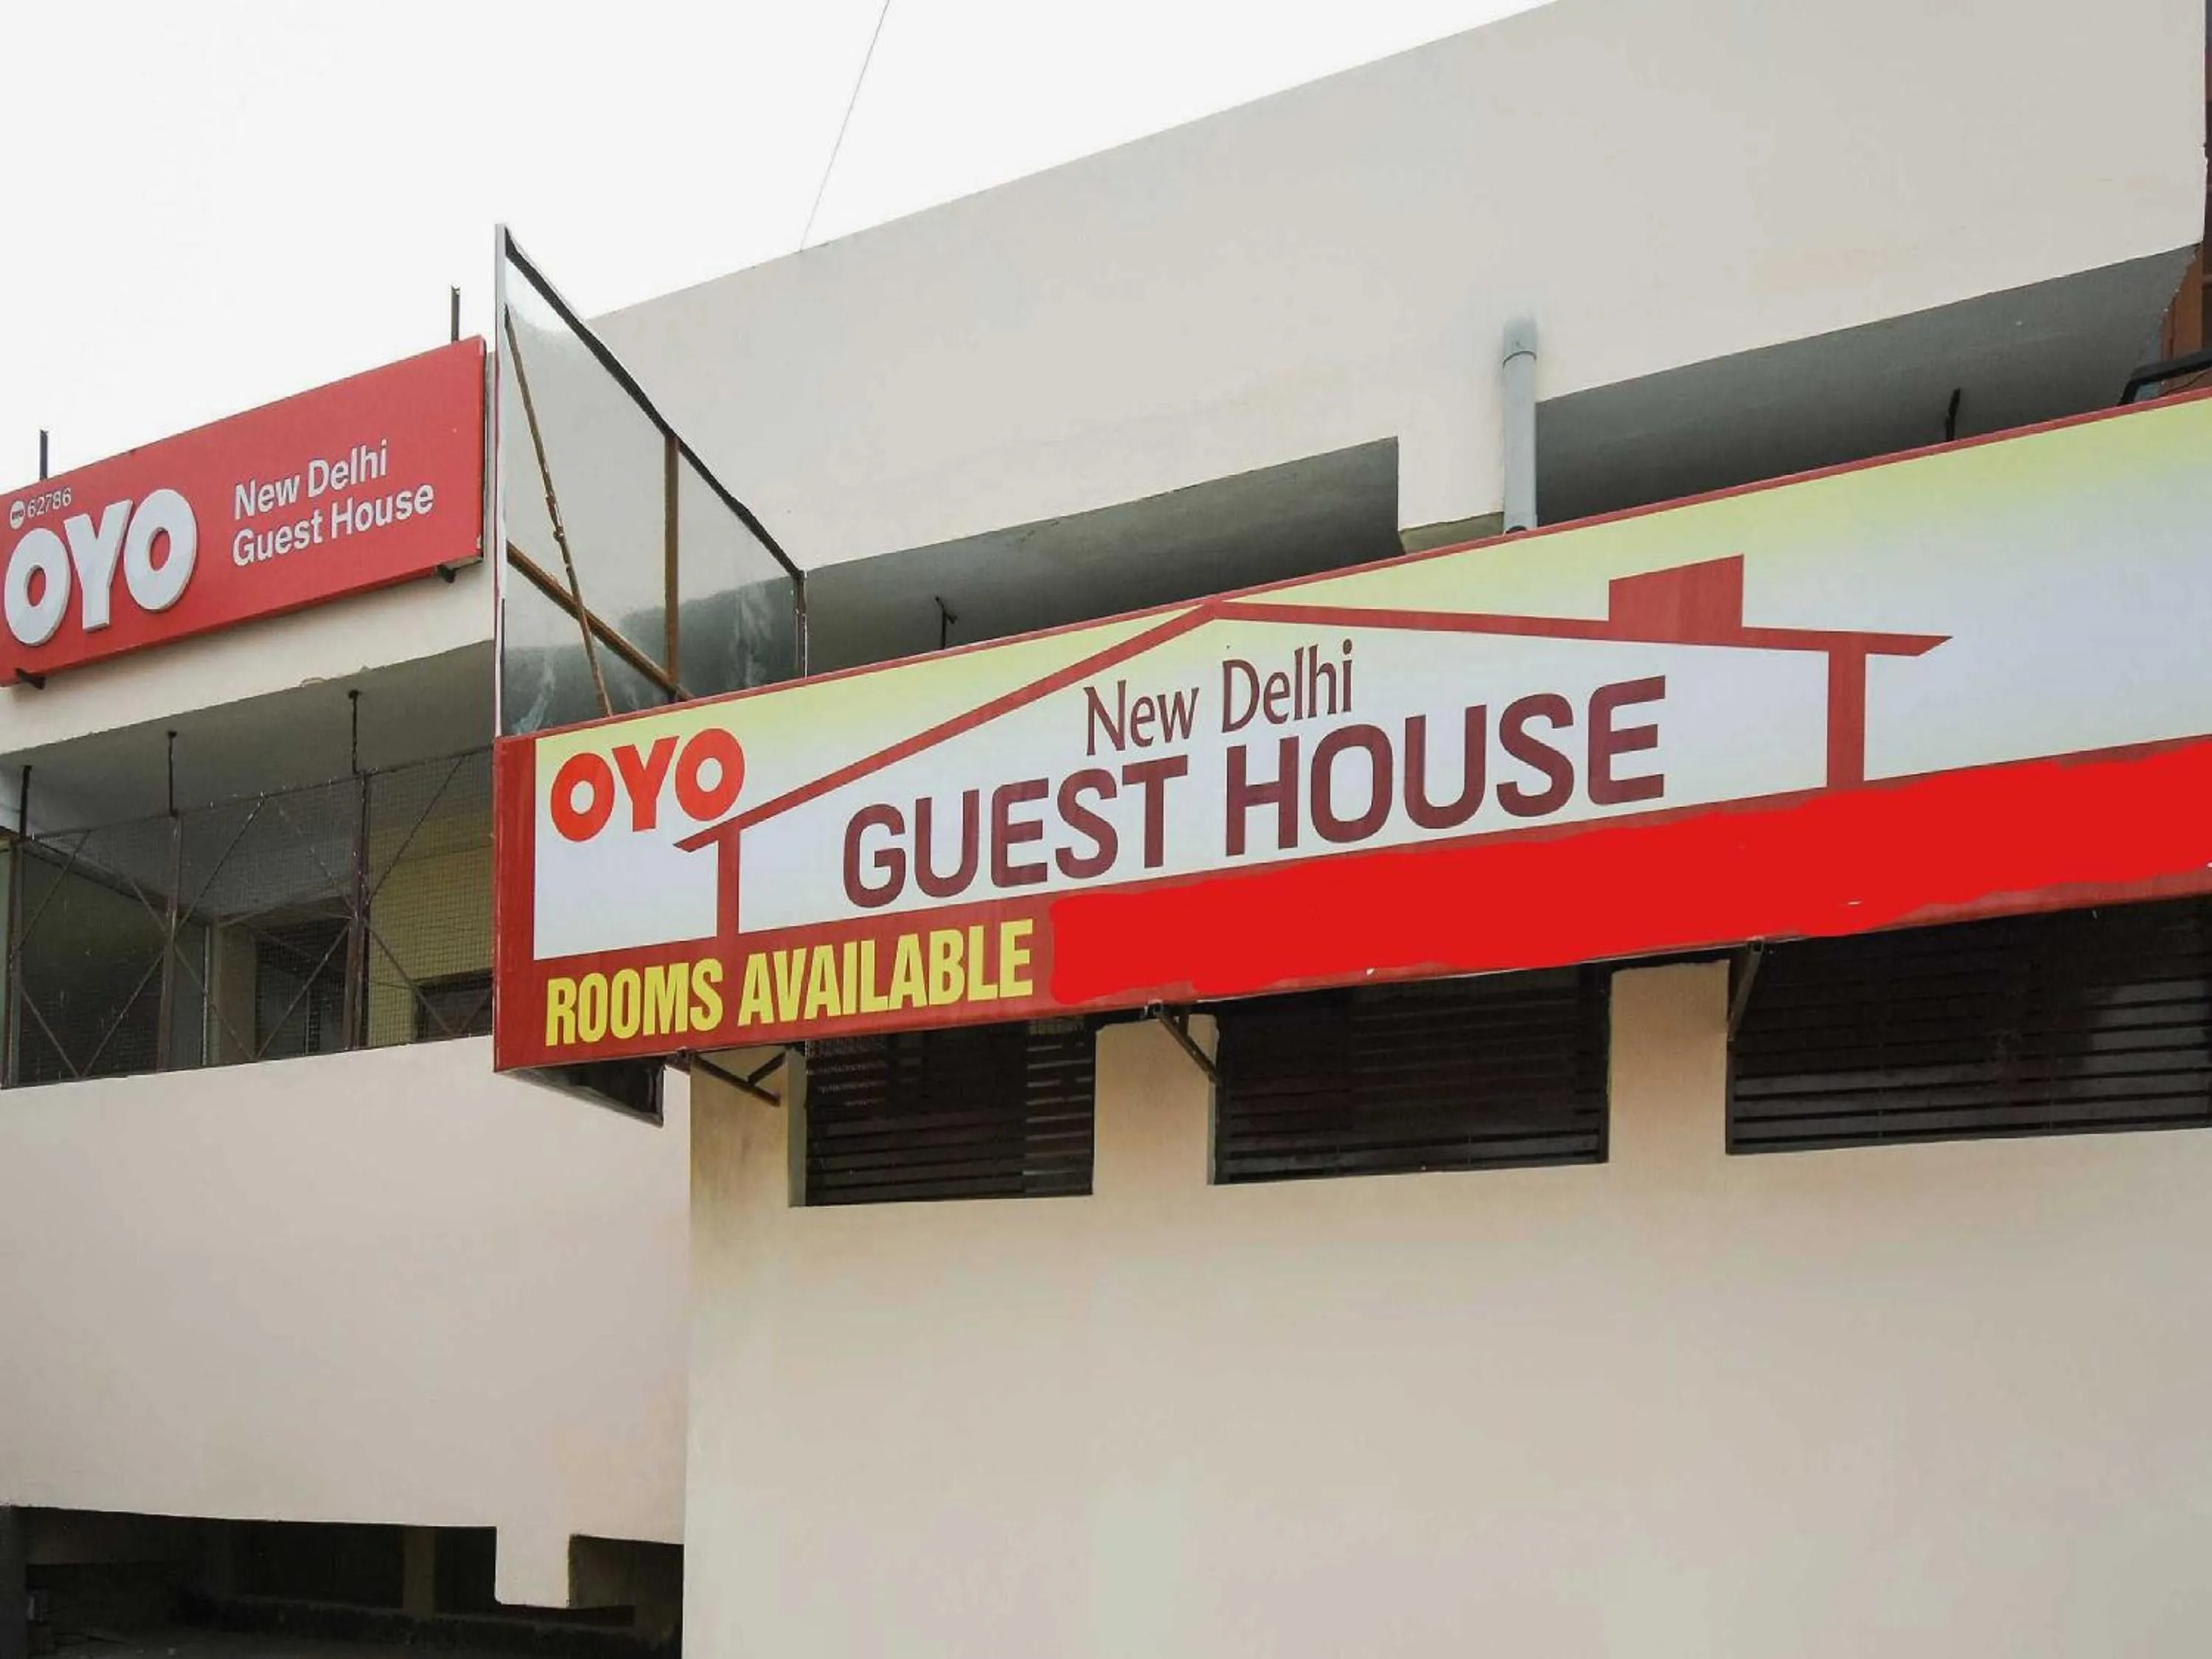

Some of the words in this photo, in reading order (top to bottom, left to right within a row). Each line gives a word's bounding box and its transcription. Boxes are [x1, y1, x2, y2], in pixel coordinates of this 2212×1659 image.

[27, 487, 72, 518] 62786
[232, 512, 323, 567] Guest
[332, 484, 435, 538] House
[234, 473, 300, 521] New
[308, 439, 389, 498] Delhi
[4, 489, 198, 646] OYO
[1084, 679, 1200, 756] New
[1222, 638, 1353, 733] Delhi
[550, 728, 745, 842] OYO
[843, 754, 1189, 908] GUEST
[1225, 675, 1666, 857] HOUSE
[545, 959, 724, 1047] ROOMS
[738, 919, 1033, 1028] AVAILABLE
